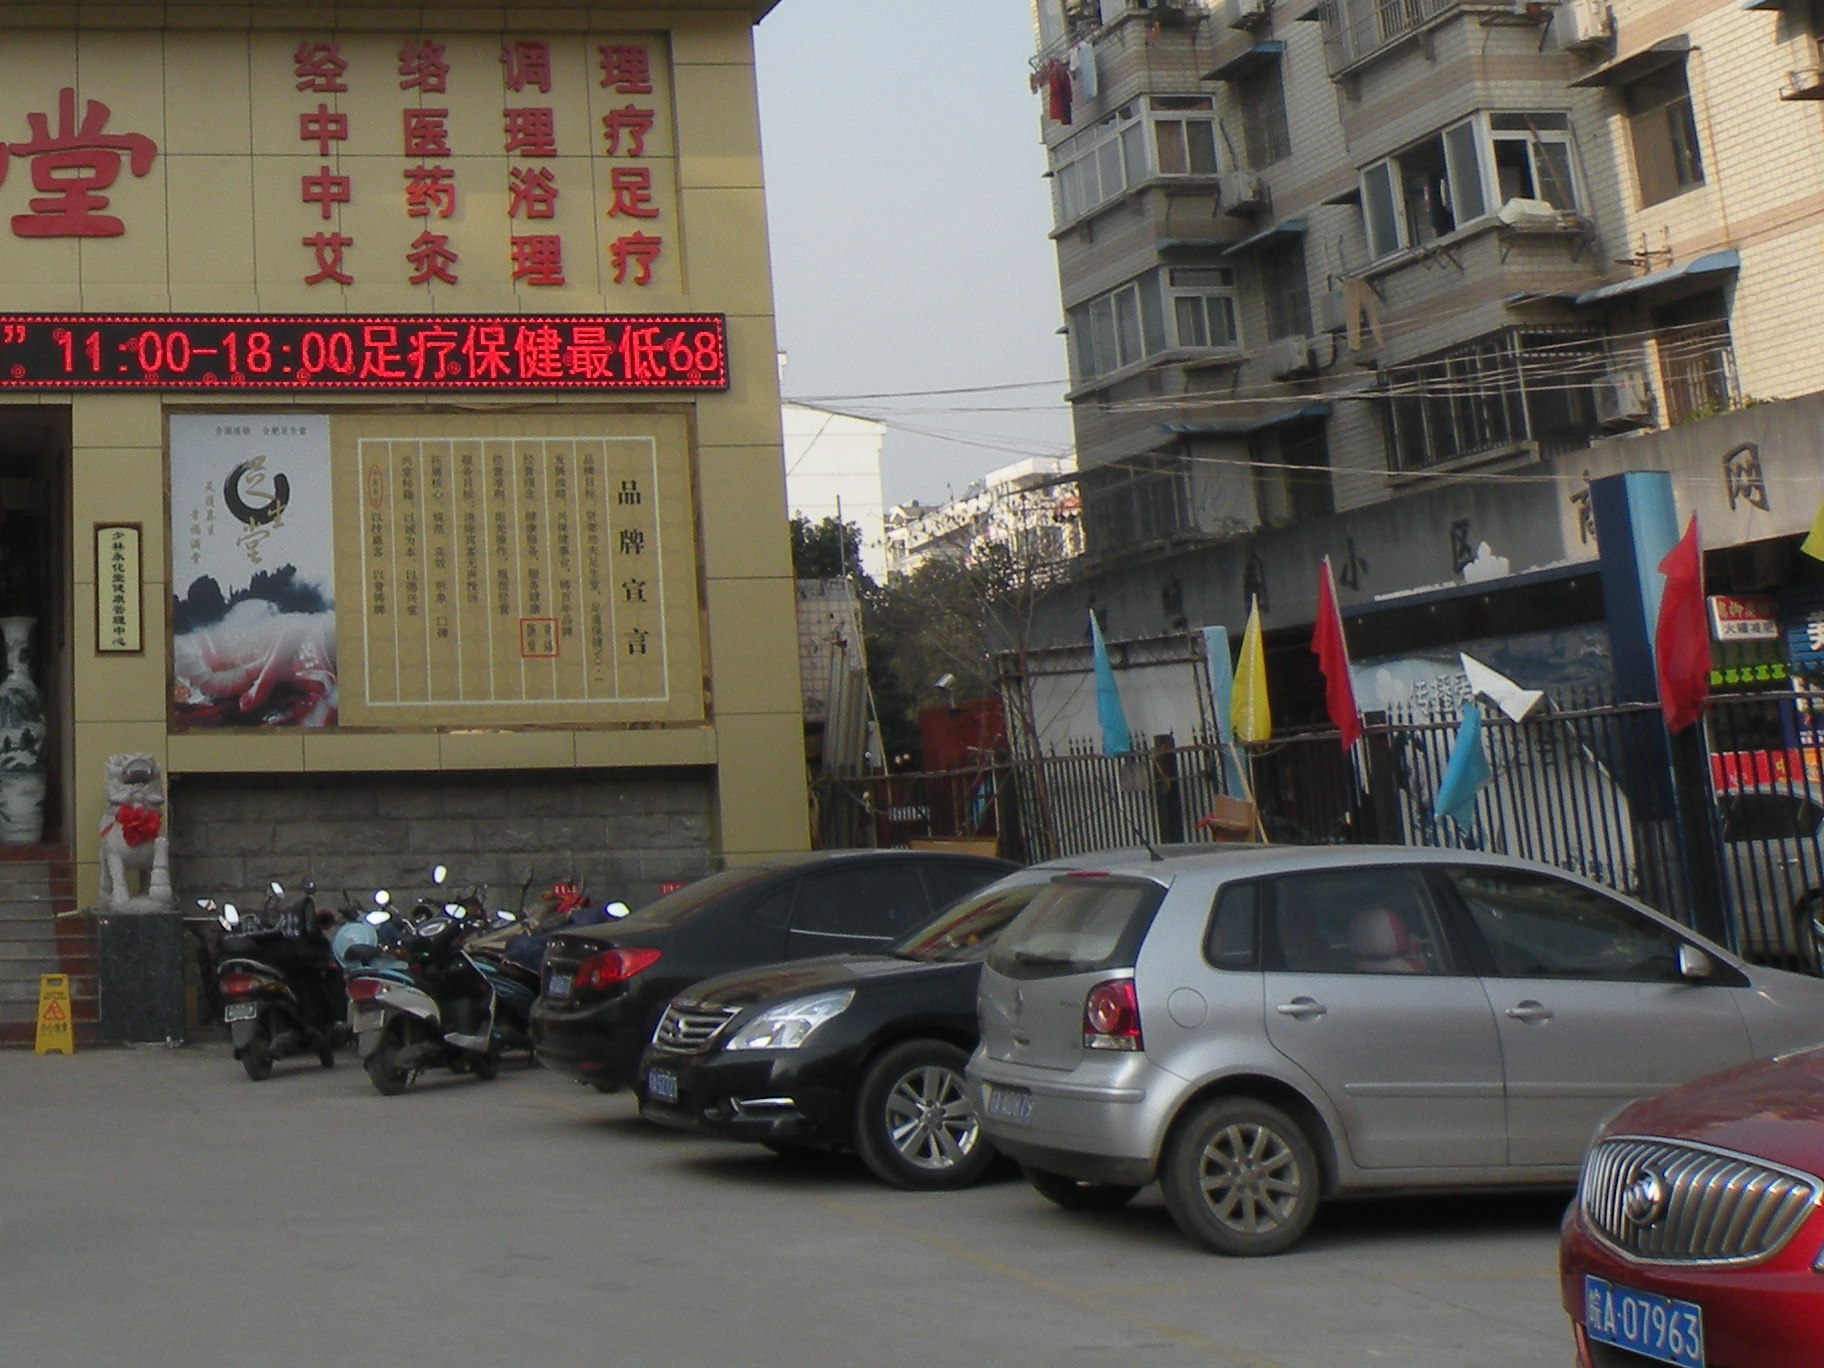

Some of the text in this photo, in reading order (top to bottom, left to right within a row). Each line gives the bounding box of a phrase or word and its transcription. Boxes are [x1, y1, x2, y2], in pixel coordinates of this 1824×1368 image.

[294, 40, 653, 94] 经络调理
[299, 104, 654, 157] 中医理疗
[302, 165, 660, 220] 中药浴足
[302, 231, 663, 286] 艾灸理疗
[618, 480, 648, 654] 品牌宣言
